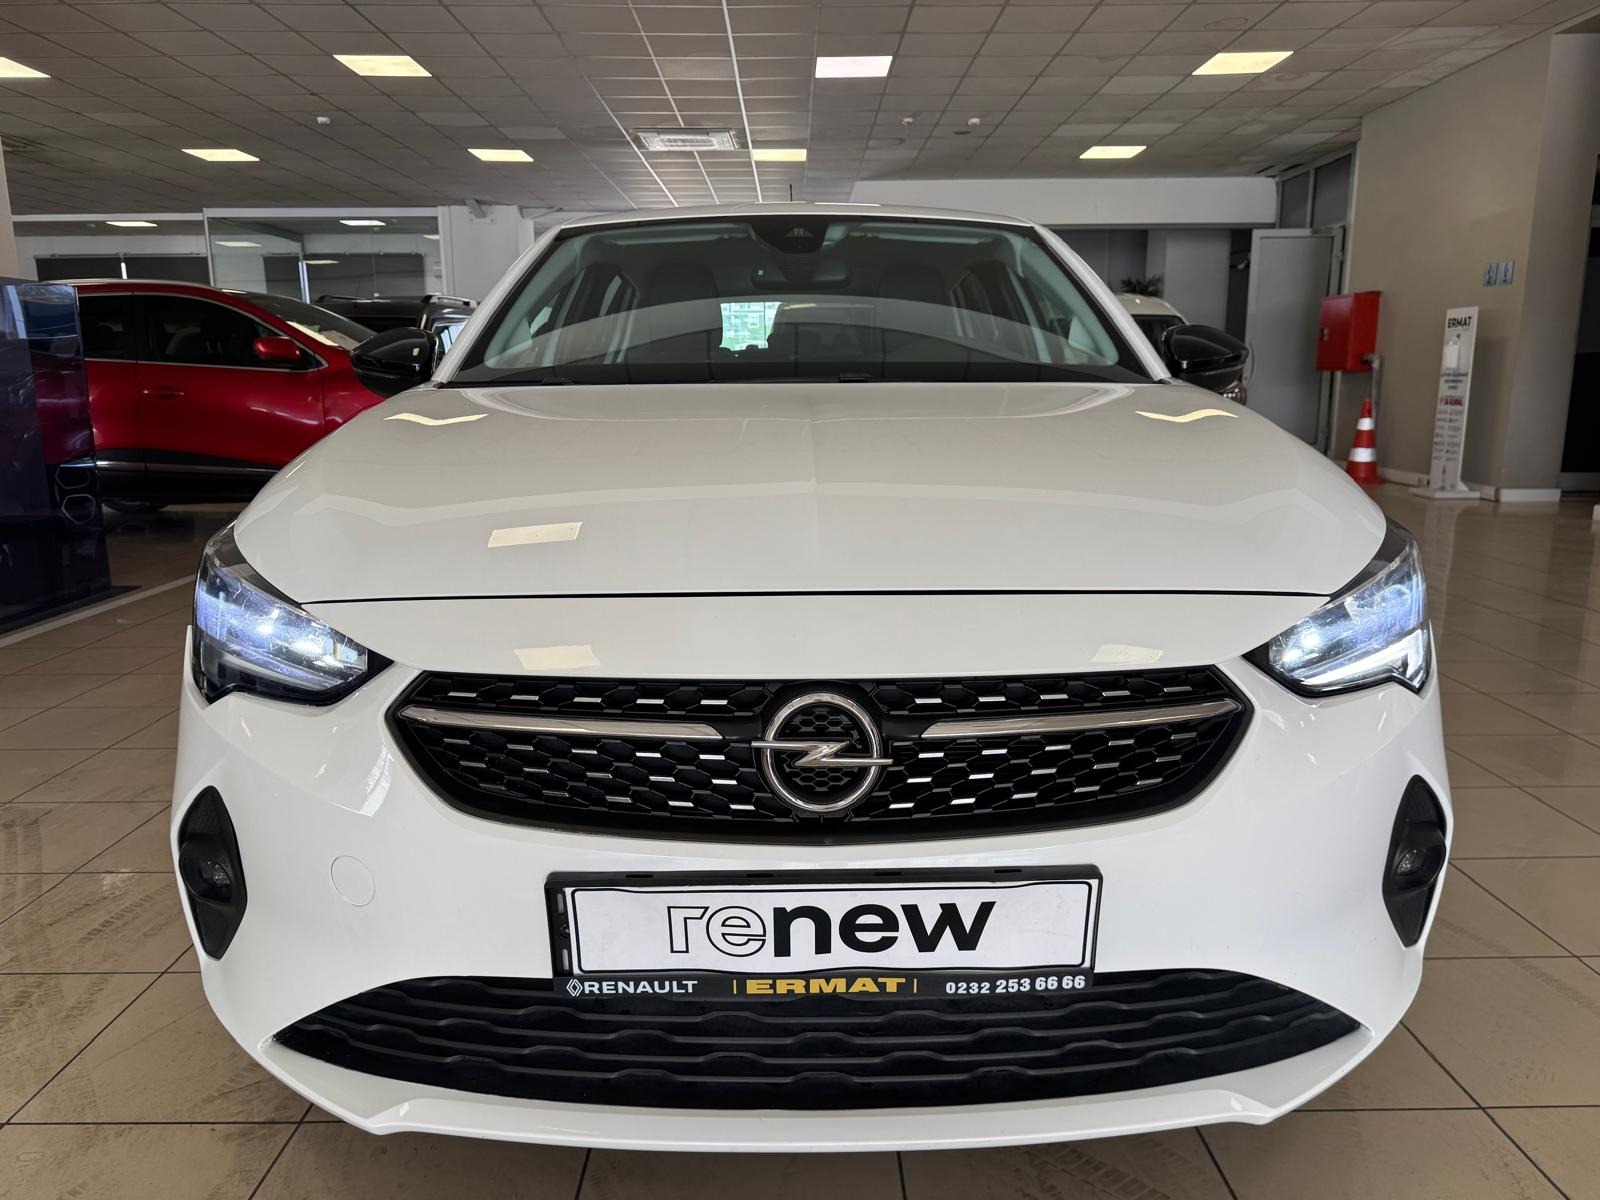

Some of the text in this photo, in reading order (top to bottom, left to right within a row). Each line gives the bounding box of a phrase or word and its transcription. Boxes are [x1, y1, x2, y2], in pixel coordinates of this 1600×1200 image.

[1447, 316, 1472, 328] ERMAT
[667, 902, 996, 958] renew
[584, 975, 1086, 994] RENAULT ERMAT 0232 253 66 66
